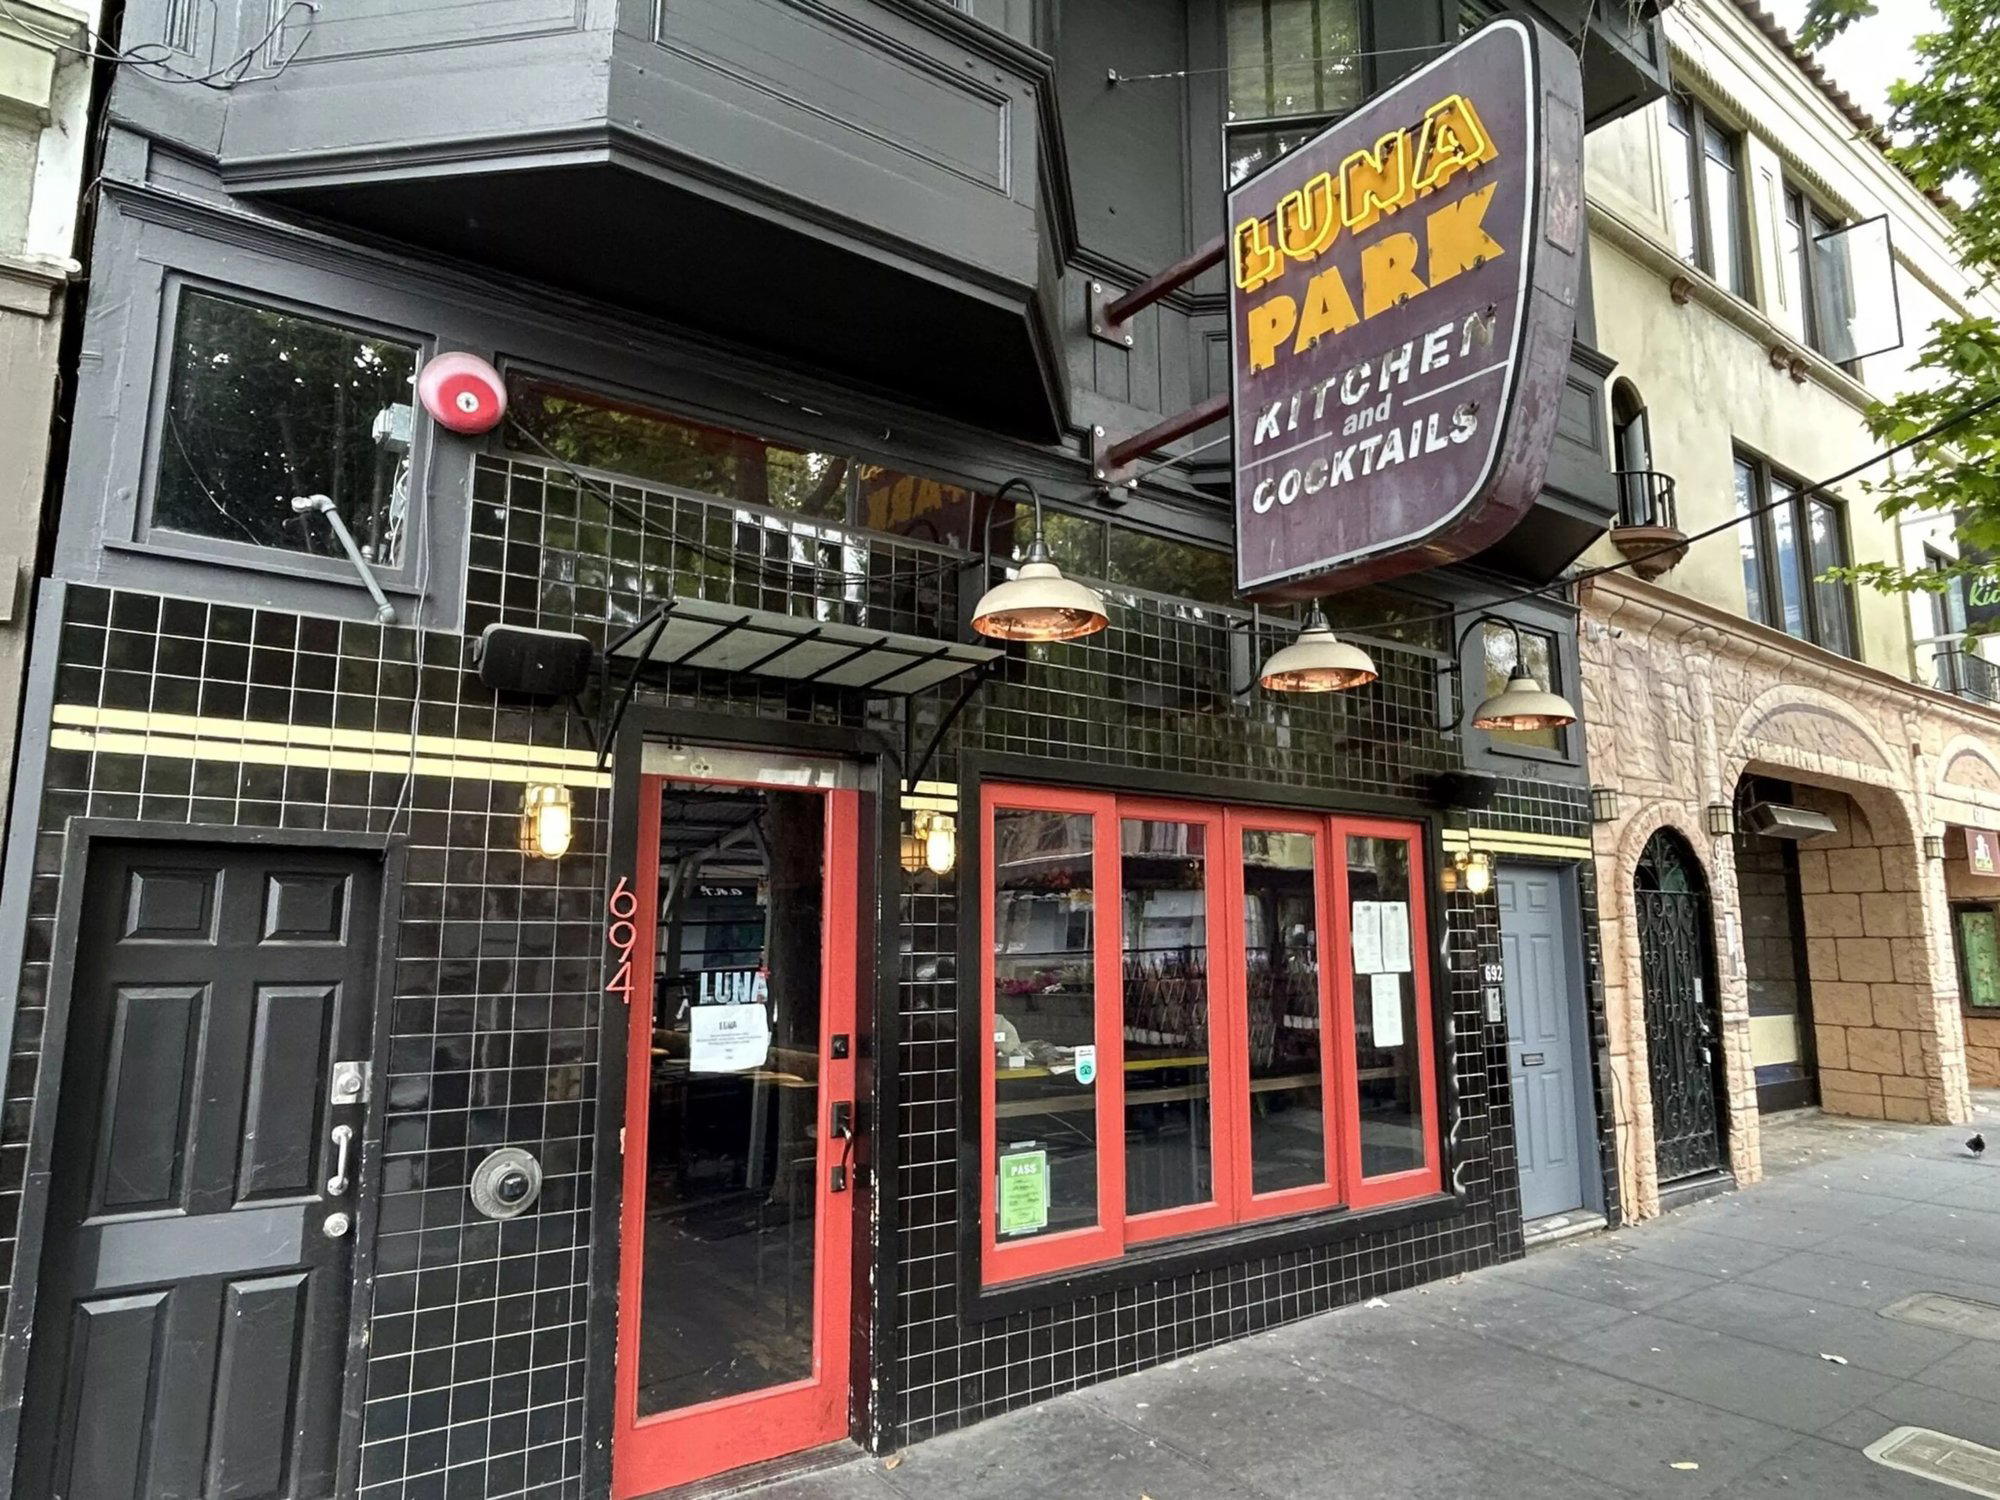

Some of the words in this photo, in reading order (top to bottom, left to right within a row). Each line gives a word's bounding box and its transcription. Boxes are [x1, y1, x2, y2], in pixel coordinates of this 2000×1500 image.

[1235, 94, 1498, 293] LUNA
[1248, 181, 1504, 375] PARK
[1253, 310, 1497, 446] KITCHEN
[1342, 393, 1392, 436] and
[1252, 403, 1479, 514] COCKTAILS
[605, 876, 638, 1005] 694
[700, 971, 768, 1004] LUNA
[1485, 964, 1503, 982] 692
[1011, 1163, 1037, 1177] PASS
